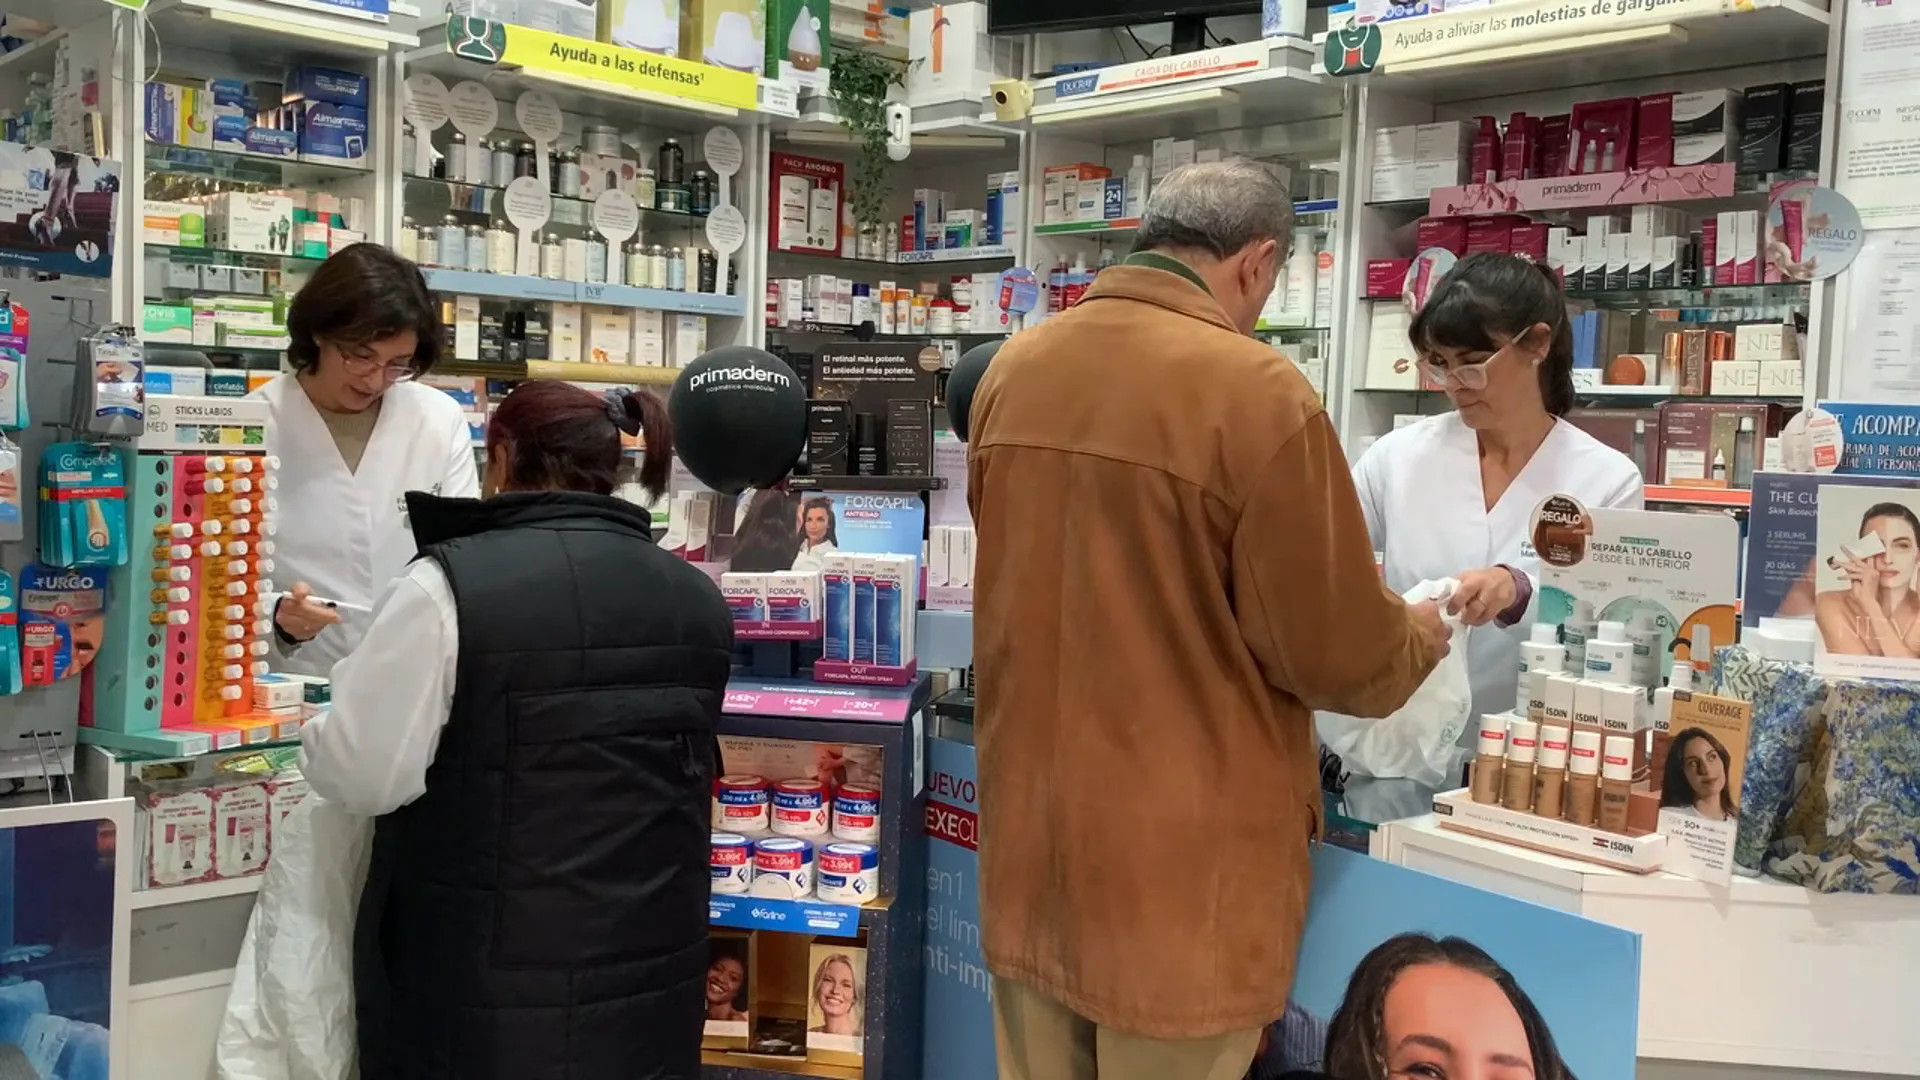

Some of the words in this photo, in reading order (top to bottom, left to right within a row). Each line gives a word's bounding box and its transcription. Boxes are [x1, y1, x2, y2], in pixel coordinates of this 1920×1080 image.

[1395, 28, 1434, 50] Ayuda
[1436, 28, 1445, 40] a
[1446, 18, 1486, 39] aliviar
[1488, 16, 1508, 34] las
[1509, 4, 1587, 29] molestias
[1590, 0, 1612, 15] de
[549, 41, 597, 65] Ayuda
[601, 56, 611, 67] a
[614, 56, 635, 73] las
[1162, 62, 1179, 74] DEL
[1180, 55, 1221, 71] CABELLO
[1062, 78, 1094, 93] DUCRAY
[805, 162, 837, 174] AHORRO
[1542, 181, 1602, 197] primaderm
[1808, 227, 1857, 241] REGALO
[900, 251, 935, 262] FORCAPIL
[832, 354, 856, 363] retinal
[857, 353, 874, 362] más
[875, 354, 907, 365] potente.
[823, 366, 830, 374] El
[832, 366, 865, 374] antiedad
[866, 365, 883, 374] más
[884, 366, 916, 377] potente.
[690, 365, 790, 392] primaderm
[213, 379, 245, 392] cinfatós
[175, 406, 203, 415] STICKS
[204, 407, 233, 416] LABIOS
[146, 421, 169, 432] MED
[1879, 444, 1890, 456] DE
[844, 495, 914, 510] FORCAPIL
[1769, 490, 1795, 504] THE
[845, 511, 880, 519] ANTIEDAD
[1768, 506, 1786, 516] Skin
[1540, 510, 1582, 526] REGALO
[1591, 542, 1629, 555] REPARA
[1631, 546, 1645, 556] TU
[1646, 547, 1692, 561] CABELLO
[1592, 552, 1624, 565] DESDE
[1625, 554, 1637, 566] EL
[1639, 556, 1691, 571] INTERIOR
[46, 576, 94, 589] URGO
[723, 587, 760, 595] FORCAPIL
[769, 587, 806, 596] FORCAPIL
[31, 626, 55, 634] URGO
[824, 672, 849, 680] FORCAPIL
[850, 666, 868, 675] OUT
[1545, 706, 1568, 719] ISDIN
[1698, 699, 1744, 720] COVERAGE
[1575, 712, 1599, 724] ISDIN
[1604, 718, 1628, 730] ISDIN
[1684, 819, 1701, 830] 50+
[1609, 840, 1635, 854] ISDIN
